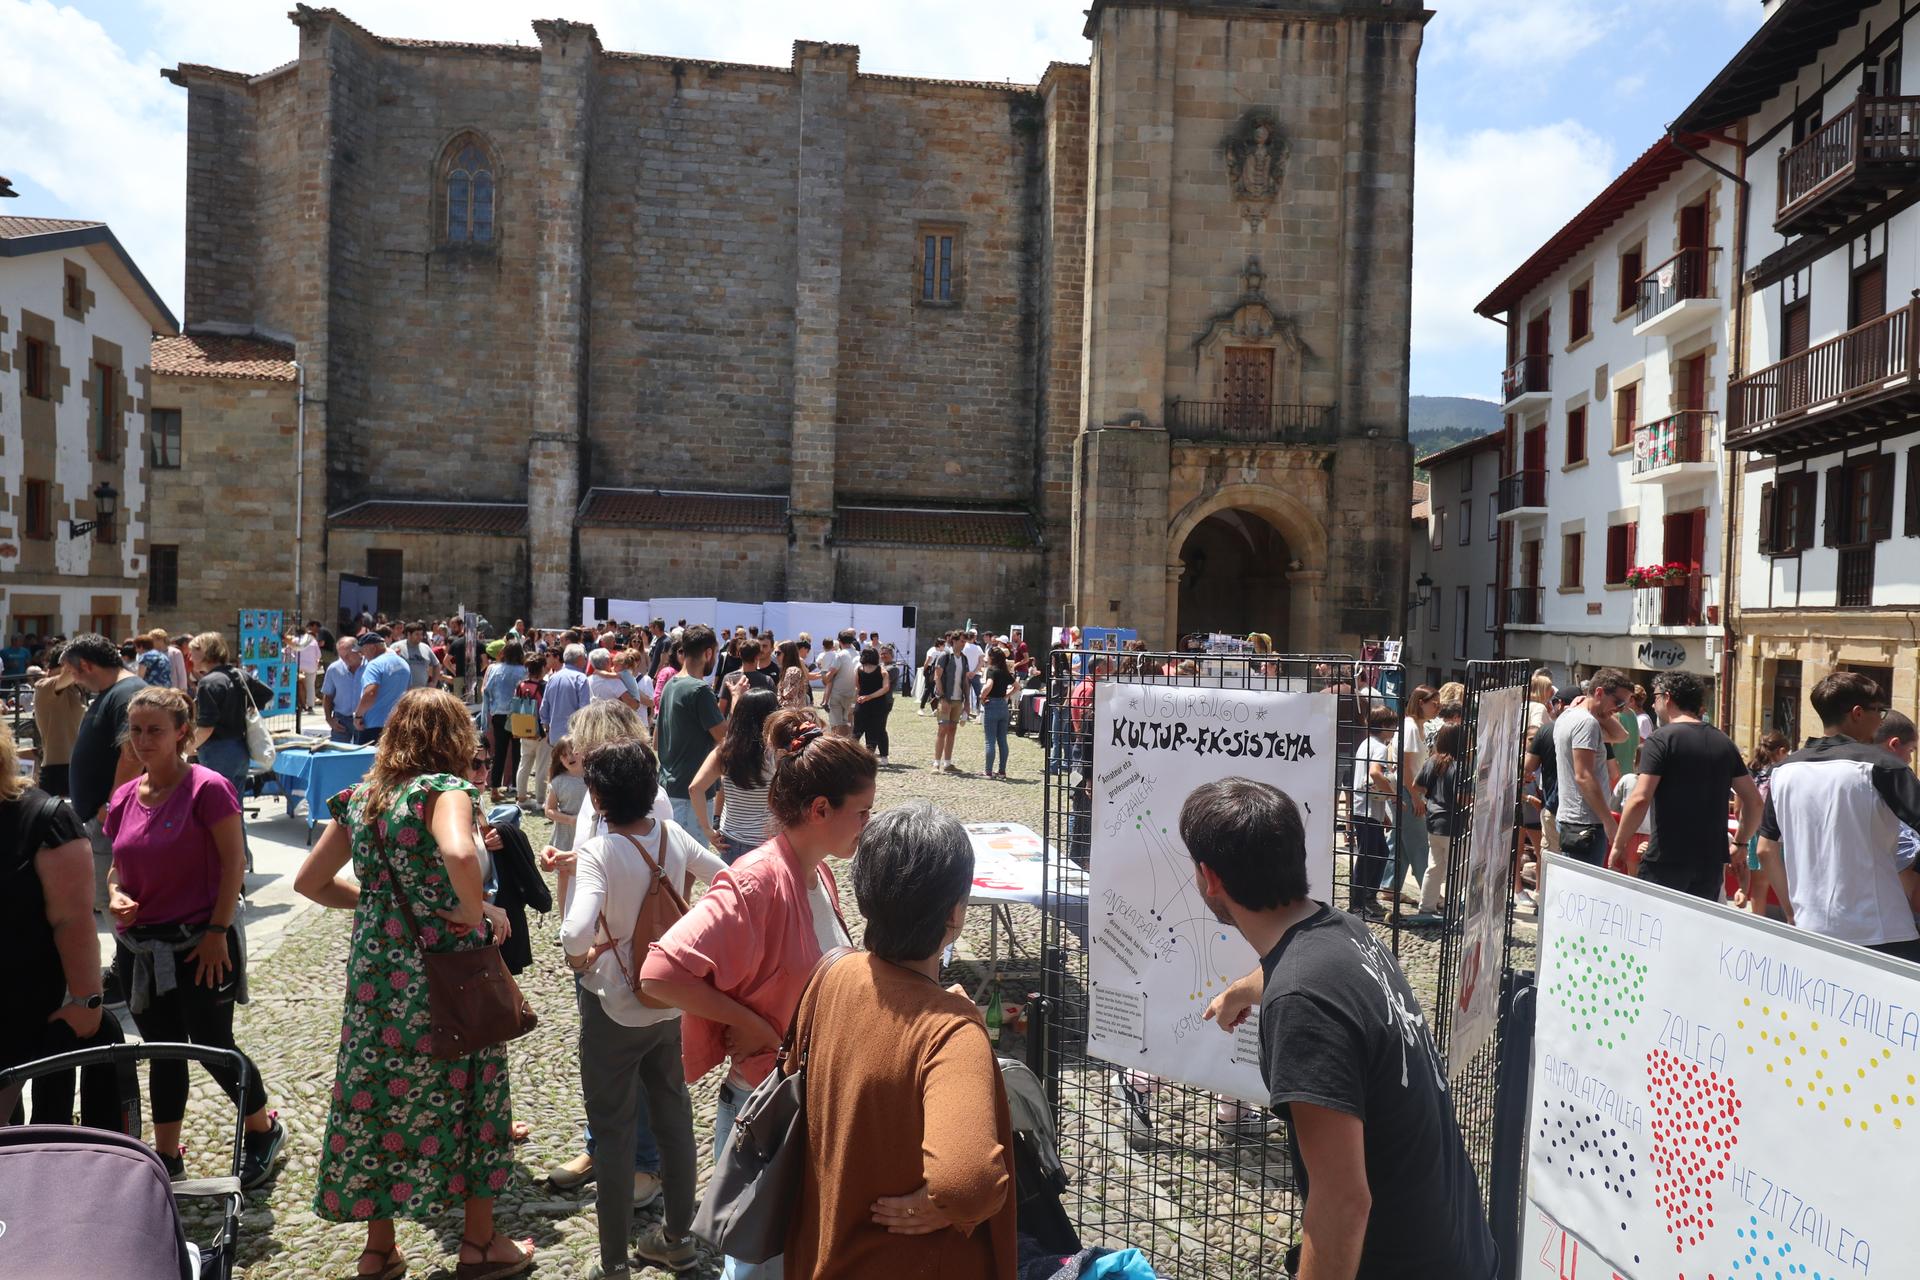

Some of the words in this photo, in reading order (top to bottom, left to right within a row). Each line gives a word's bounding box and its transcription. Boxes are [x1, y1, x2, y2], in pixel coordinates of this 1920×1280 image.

[1638, 642, 1686, 666] Marije
[1122, 760, 1133, 771] eta
[1557, 889, 1663, 953] SORTZAILEA
[1719, 940, 1920, 1051] KOMUNIKATZAILEA
[1657, 1008, 1727, 1072] ZALEA
[1543, 1053, 1642, 1136] ANTOLATZAILEA
[1732, 1162, 1871, 1277] HEZITZAILEA
